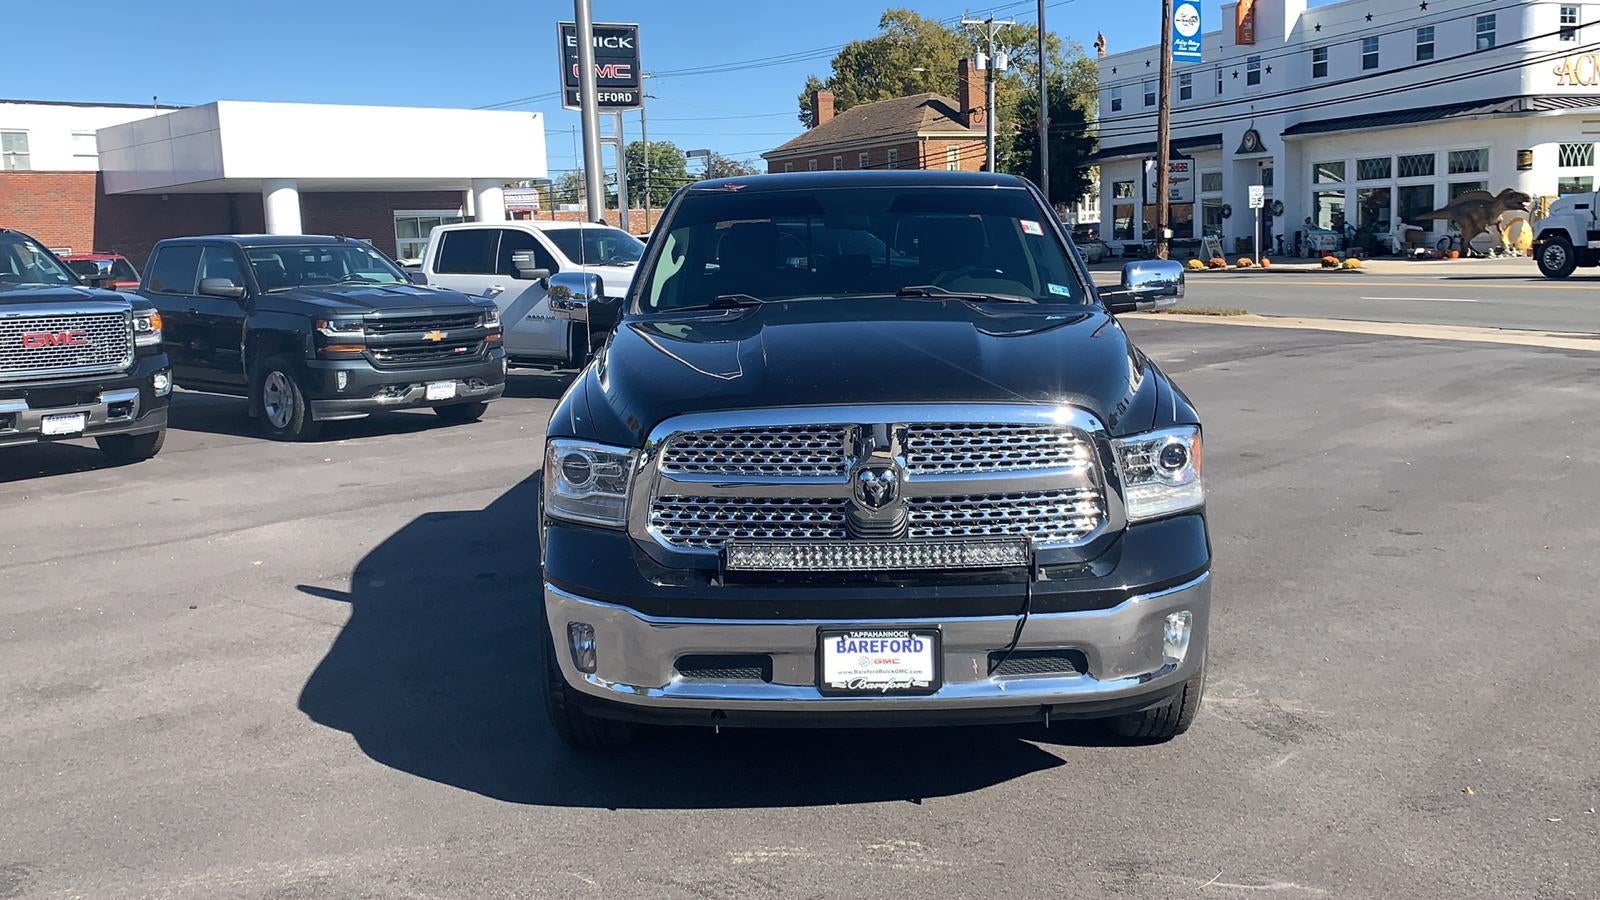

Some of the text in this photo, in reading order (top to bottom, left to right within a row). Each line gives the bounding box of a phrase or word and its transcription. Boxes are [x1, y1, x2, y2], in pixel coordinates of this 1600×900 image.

[566, 35, 634, 49] BICK
[576, 92, 632, 102] BEFORD
[1251, 197, 1263, 206] 25
[23, 330, 88, 348] GMC
[836, 640, 924, 654] BAREFORD
[847, 676, 915, 693] Bareford
